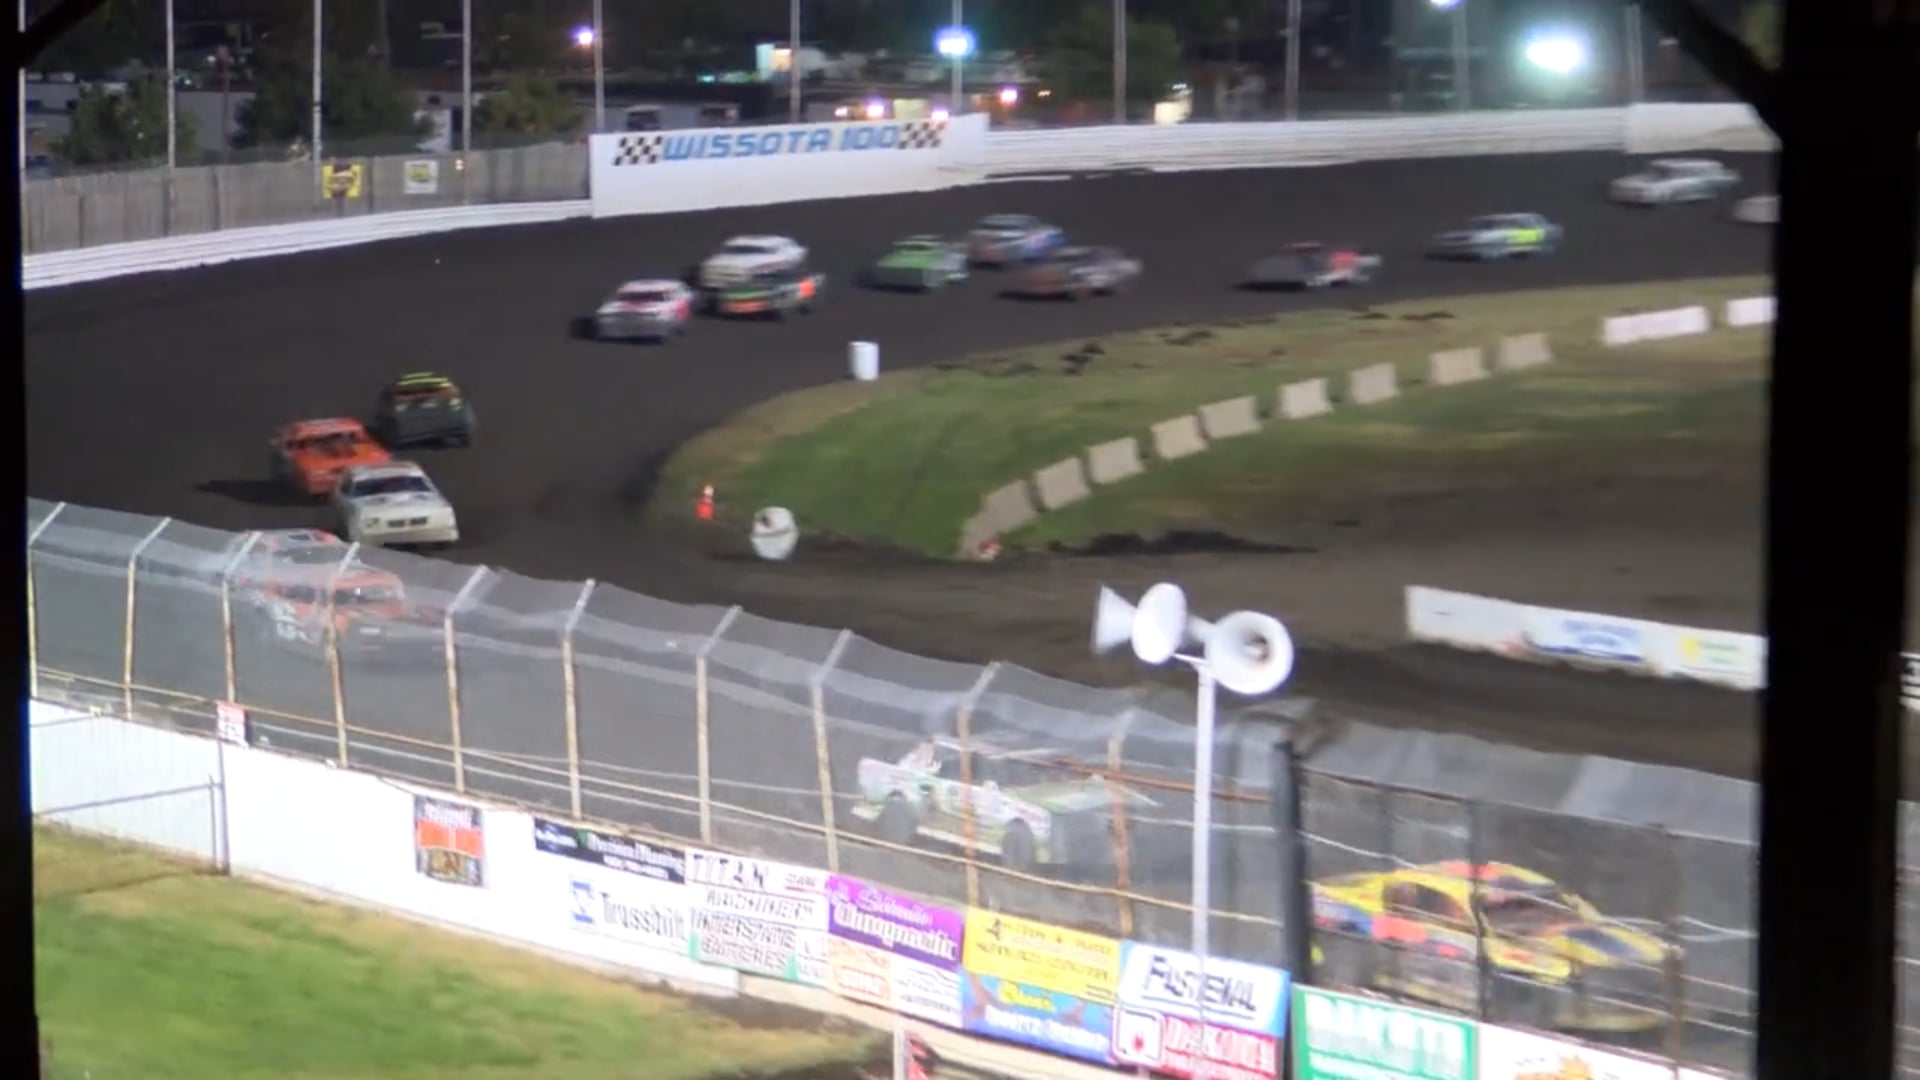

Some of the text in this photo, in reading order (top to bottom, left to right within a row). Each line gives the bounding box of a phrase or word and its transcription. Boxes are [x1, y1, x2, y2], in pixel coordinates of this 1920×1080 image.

[663, 125, 898, 161] WISSOTA 100
[693, 853, 768, 889] TITAN
[690, 906, 797, 950] INTERSTATE
[1143, 954, 1257, 1011] FASTENAL
